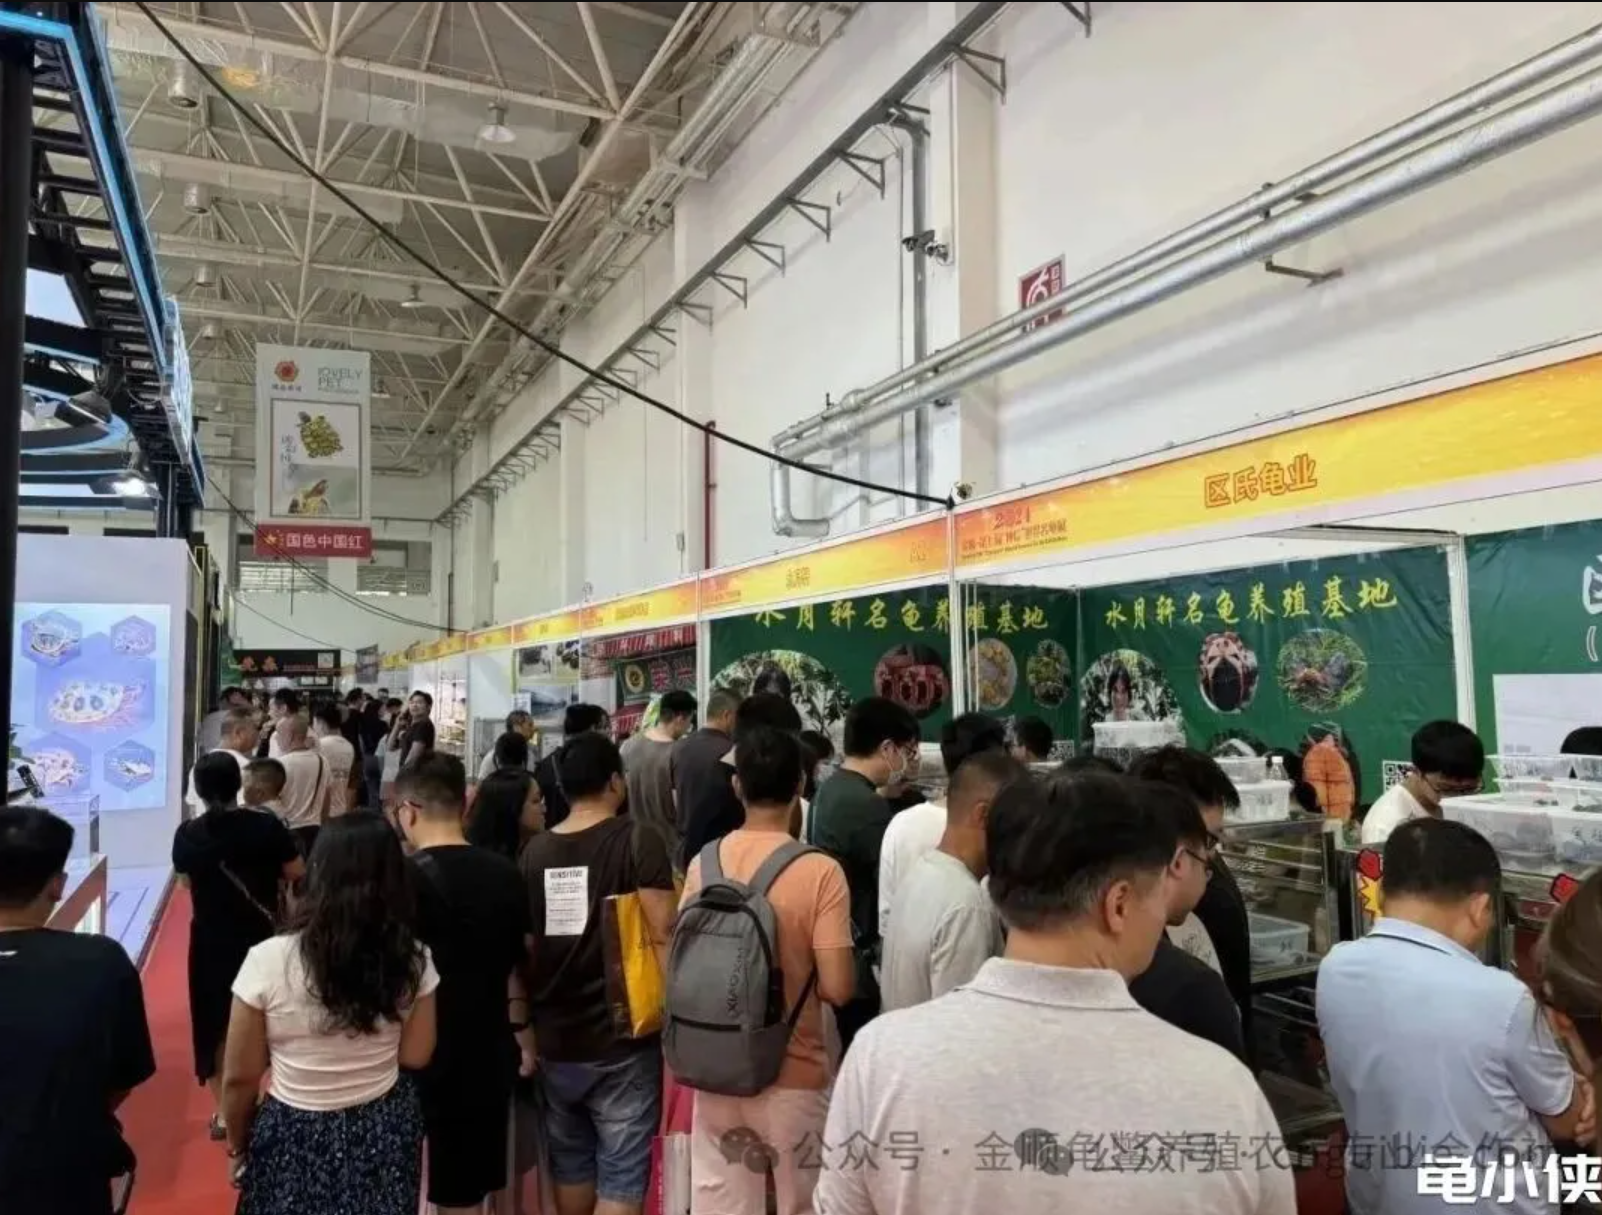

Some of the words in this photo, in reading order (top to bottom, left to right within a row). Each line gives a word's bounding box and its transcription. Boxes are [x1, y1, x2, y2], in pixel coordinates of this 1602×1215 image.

[1204, 453, 1317, 508] 区氏龟业
[1105, 576, 1398, 629] 水月轩名龟养殖基地
